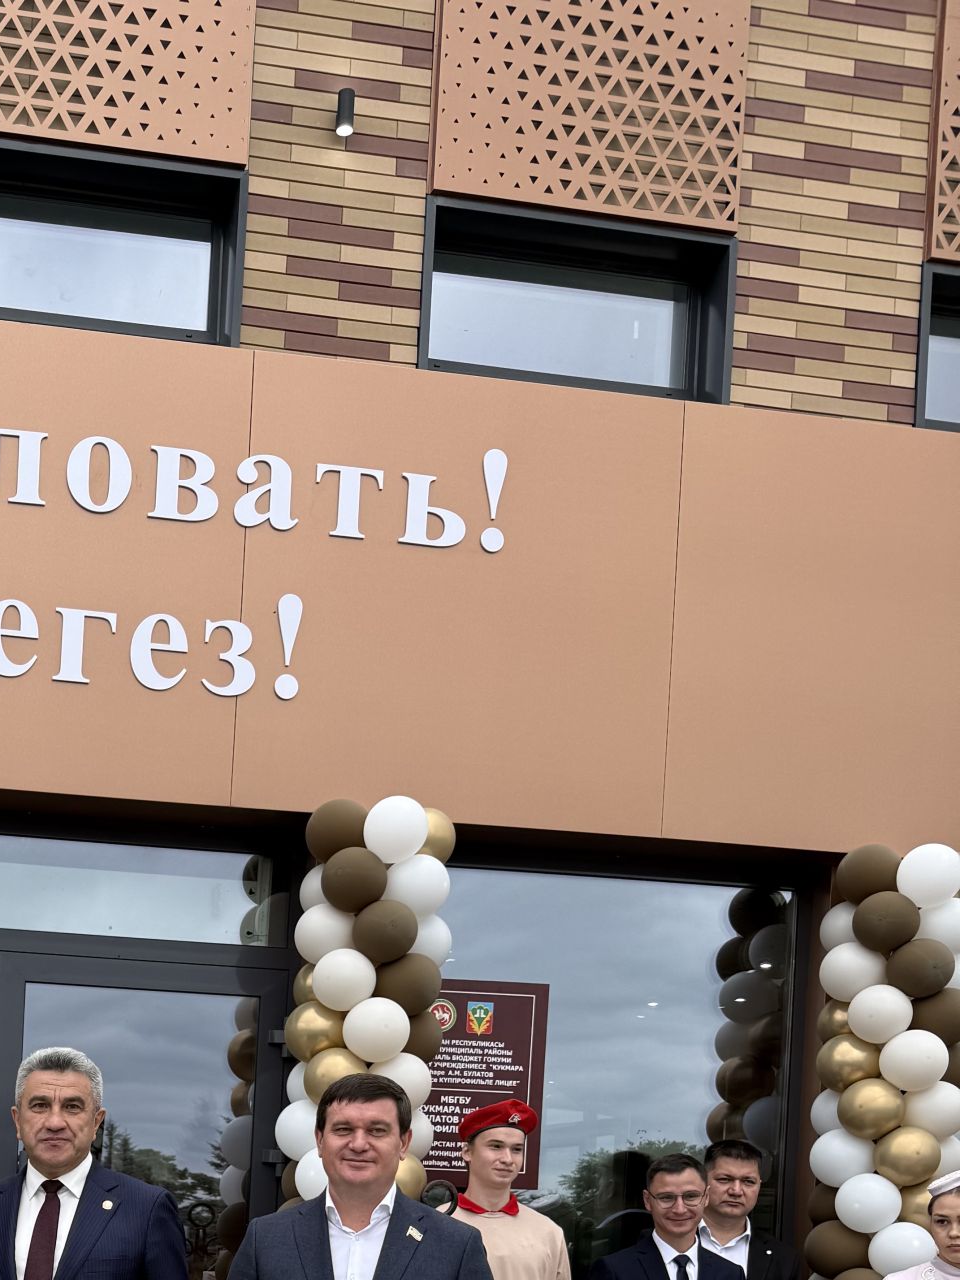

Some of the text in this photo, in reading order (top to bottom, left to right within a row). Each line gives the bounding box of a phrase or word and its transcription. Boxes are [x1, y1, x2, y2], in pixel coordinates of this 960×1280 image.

[451, 1039, 505, 1048] РЕСПУБЛИКАСЫ
[484, 1048, 513, 1056] РАЙОНЫ
[440, 1095, 471, 1104] МБГБУ
